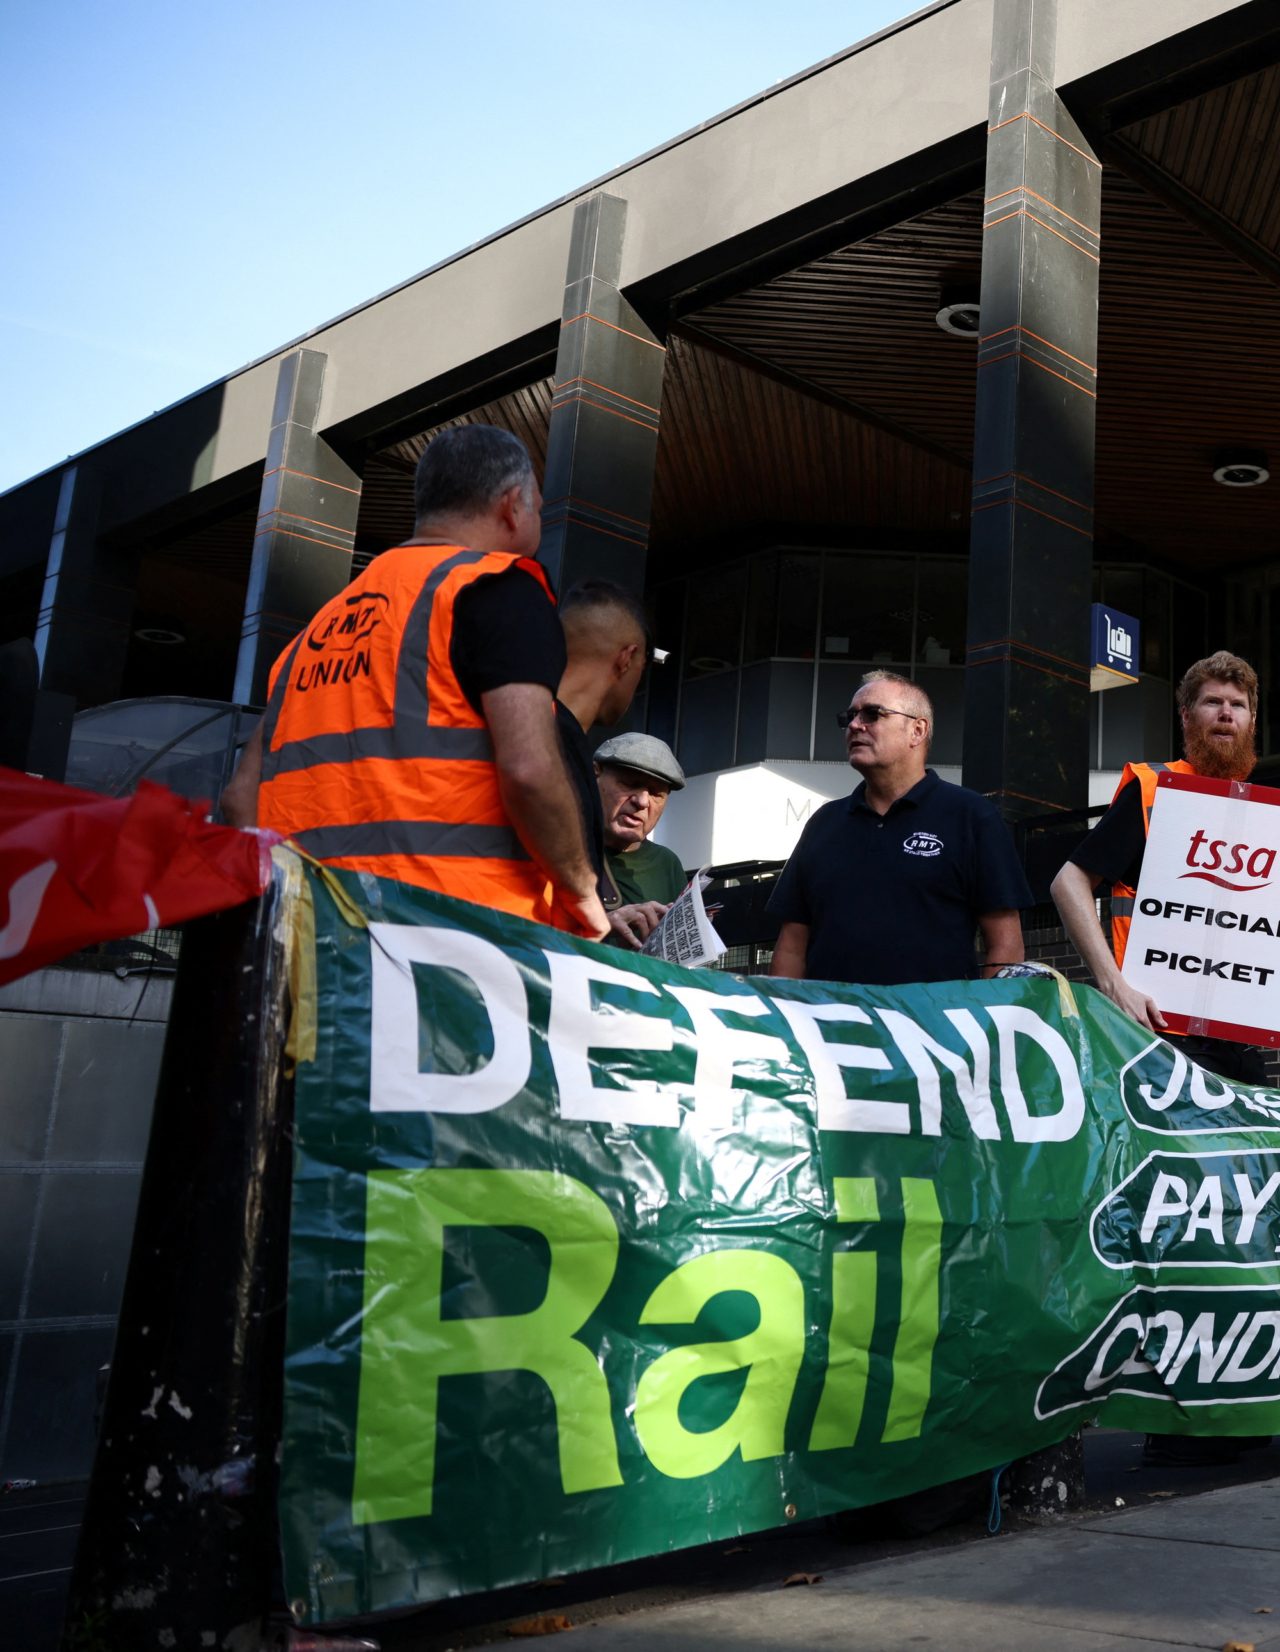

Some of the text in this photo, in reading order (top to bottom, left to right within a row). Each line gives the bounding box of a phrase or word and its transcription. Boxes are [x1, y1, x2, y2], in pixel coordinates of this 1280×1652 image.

[322, 605, 376, 639] RMT
[296, 649, 371, 692] UNION
[911, 840, 937, 849] RMT
[1185, 829, 1277, 880] tssa
[678, 929, 690, 951] STRIKE
[688, 928, 701, 946] CALL
[691, 944, 704, 959] FOR
[680, 951, 692, 961] TO
[1144, 949, 1275, 986] PICKET
[370, 922, 1086, 1143] DEFEND
[351, 1169, 944, 1525] Rail
